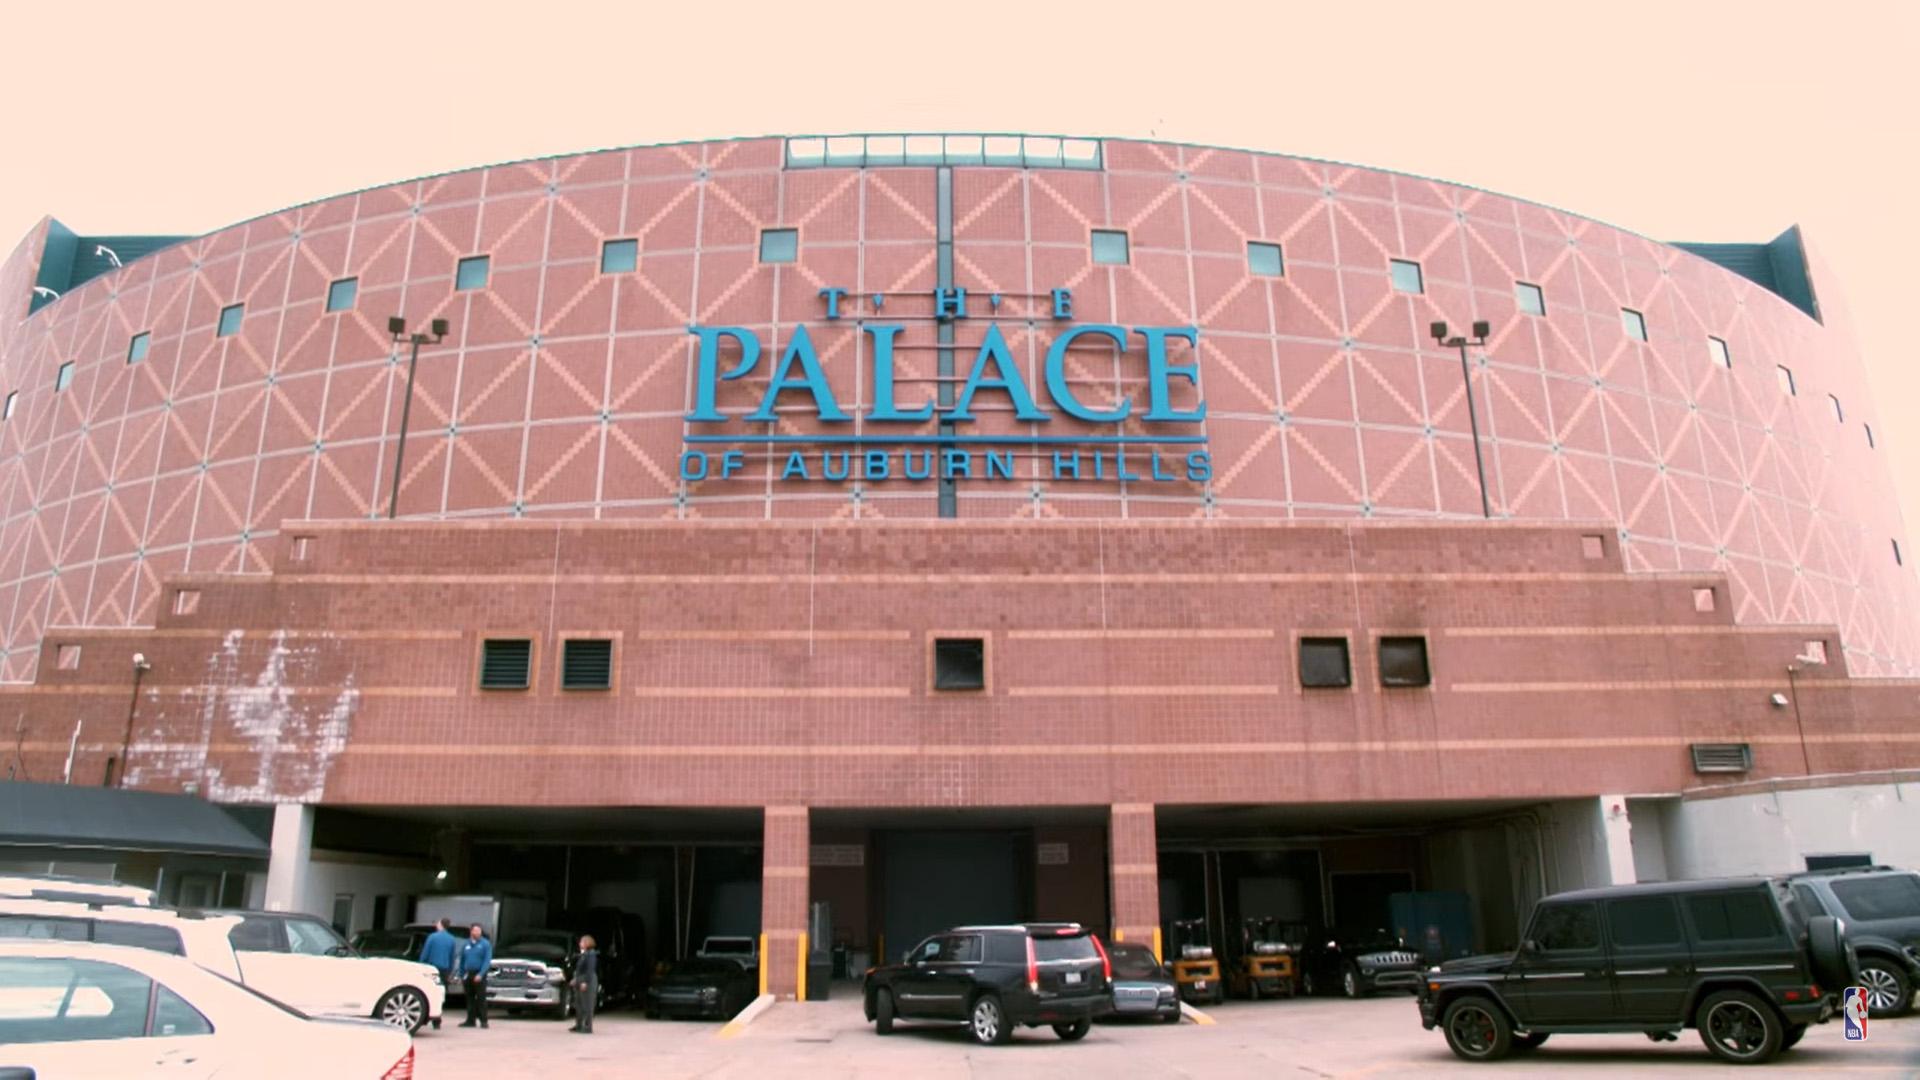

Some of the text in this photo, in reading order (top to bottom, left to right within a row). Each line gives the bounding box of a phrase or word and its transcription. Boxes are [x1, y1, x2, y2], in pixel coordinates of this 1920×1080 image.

[818, 287, 1073, 320] THE
[684, 323, 1207, 423] PALACE
[680, 450, 1212, 481] OF AUBURN HILLS
